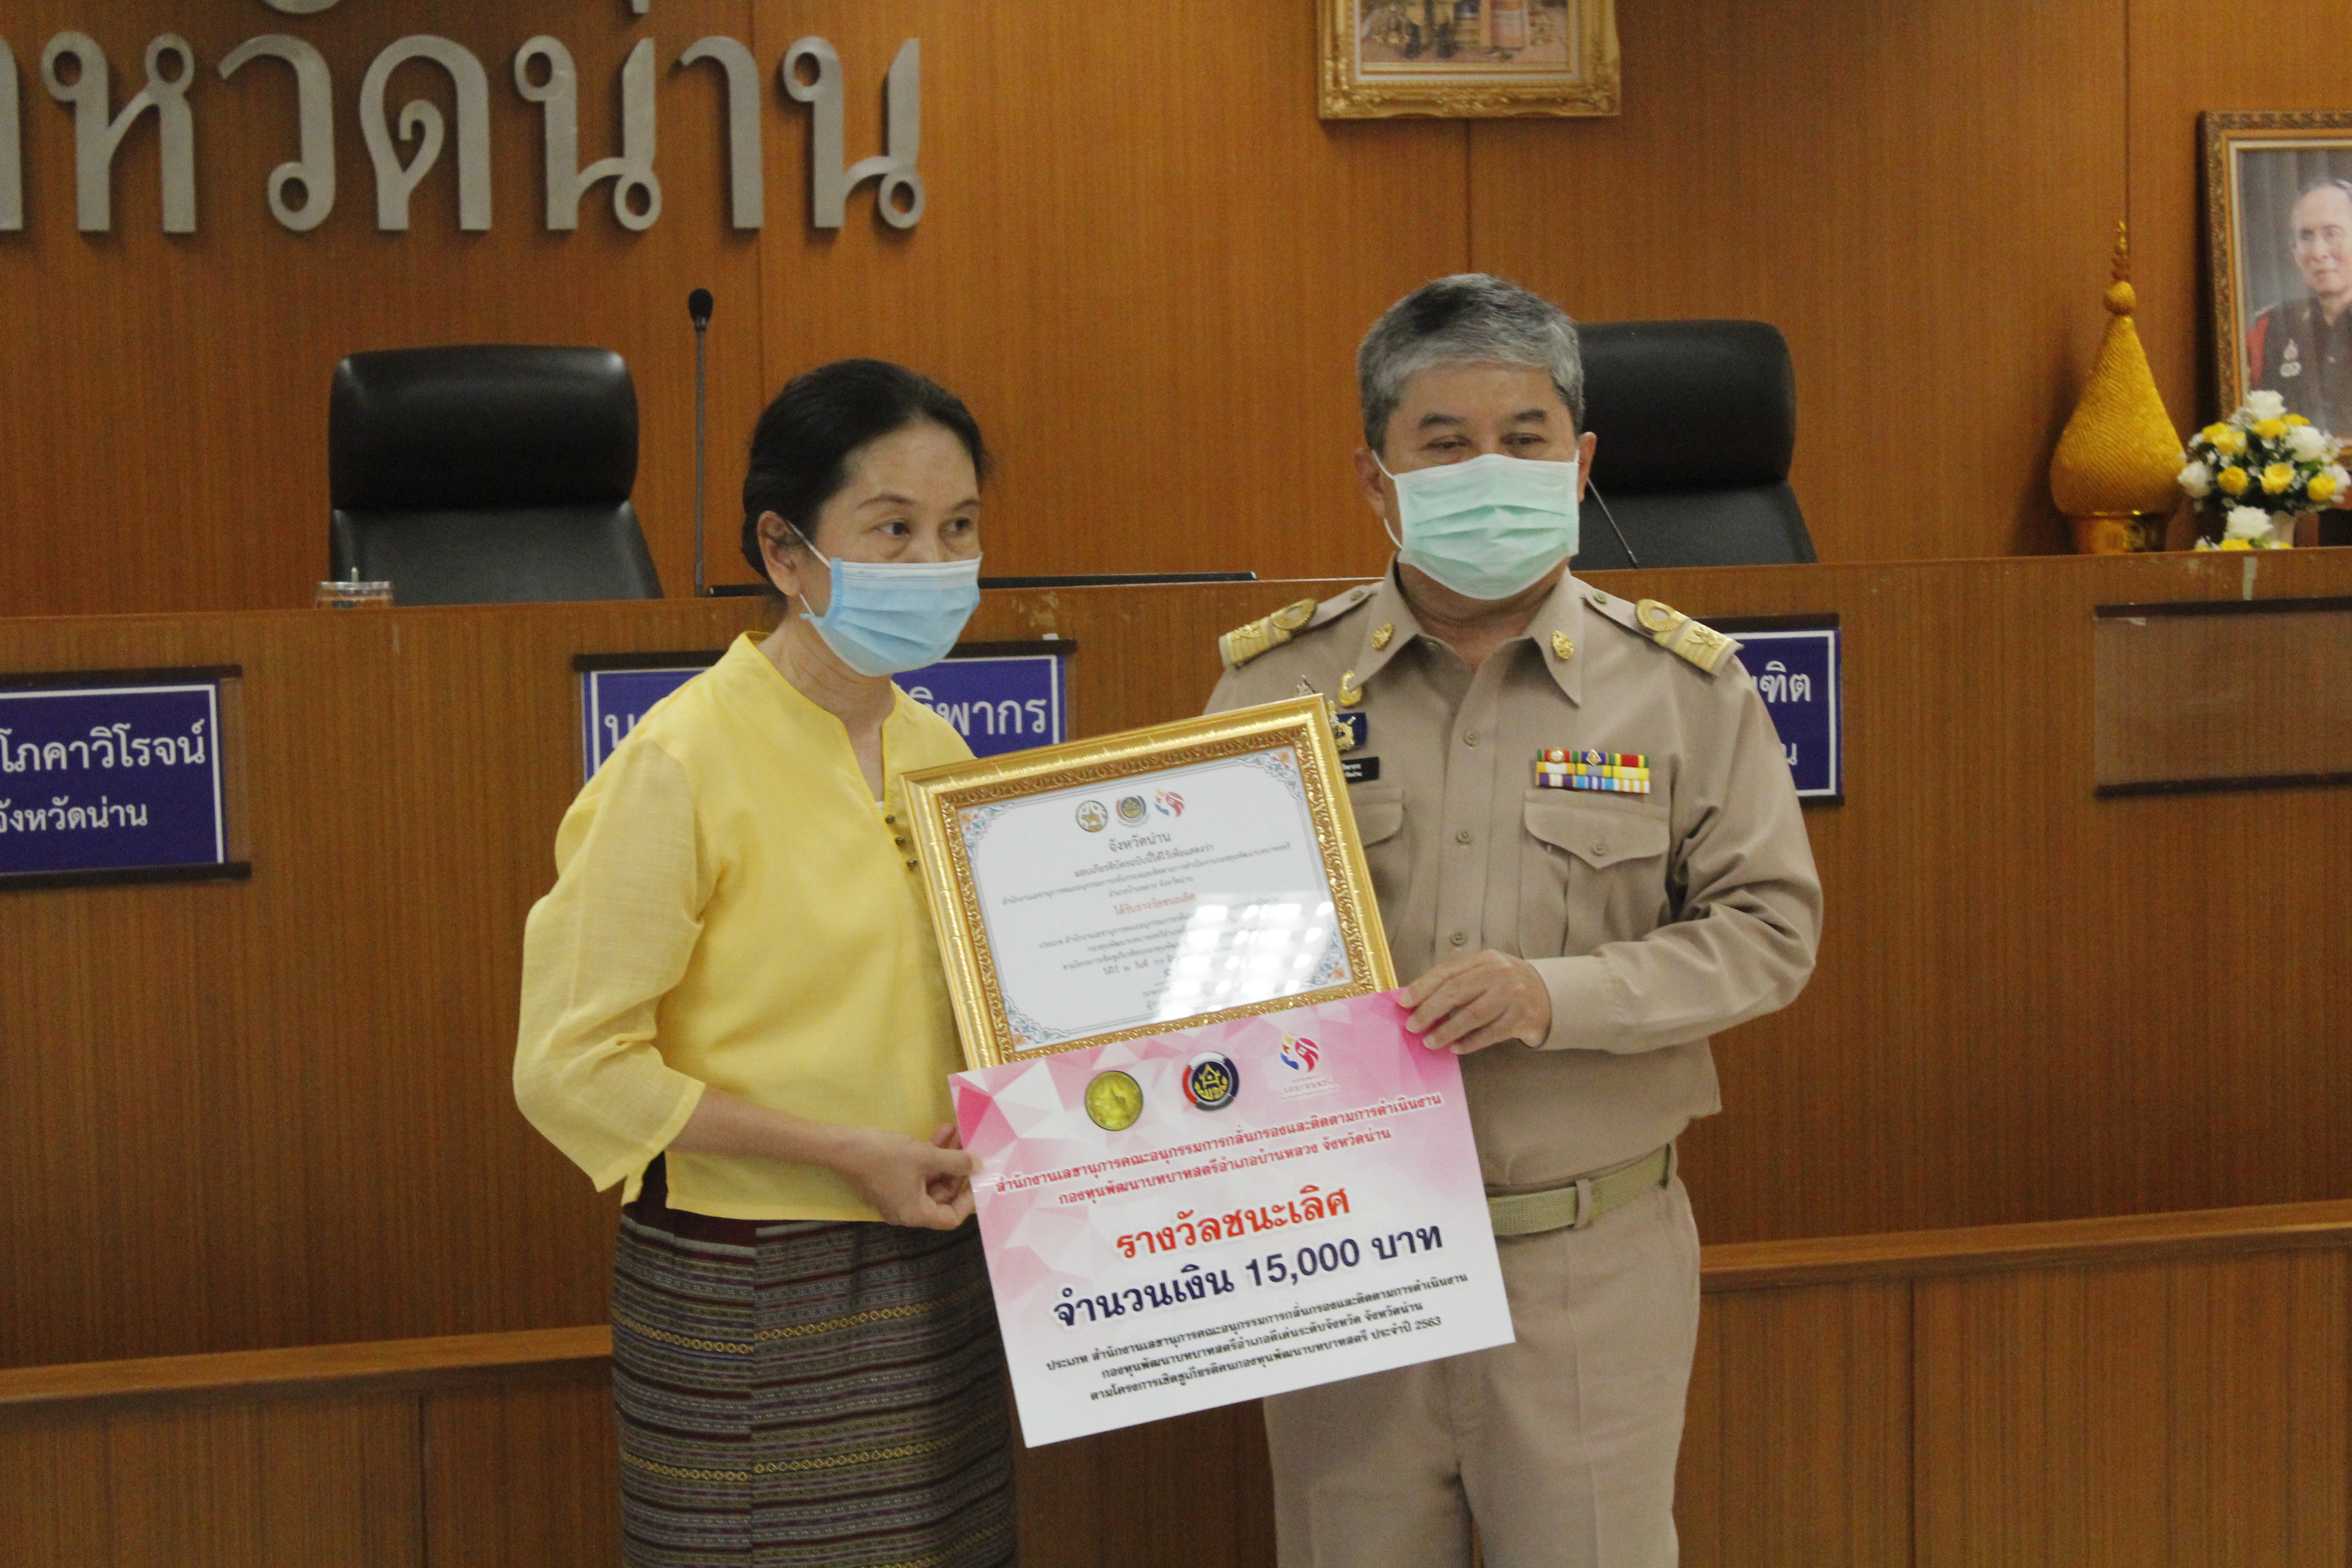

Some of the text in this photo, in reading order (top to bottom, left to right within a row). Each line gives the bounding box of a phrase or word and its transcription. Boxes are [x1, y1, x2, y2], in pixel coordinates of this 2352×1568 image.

[1752, 660, 1812, 704] ฑิต
[1323, 1127, 1391, 1150] จังหวัดน่าน
[1116, 1184, 1350, 1259] รางวัลชนะเลิศ
[1053, 1225, 1443, 1327] จำนวนเงิน 15,000 บาท
[1364, 1301, 1423, 1321] จังหวัดน่าน
[1371, 1320, 1411, 1339] ประจำปี
[1414, 1316, 1441, 1330] 2563
[1046, 1354, 1088, 1371] ประเภท
